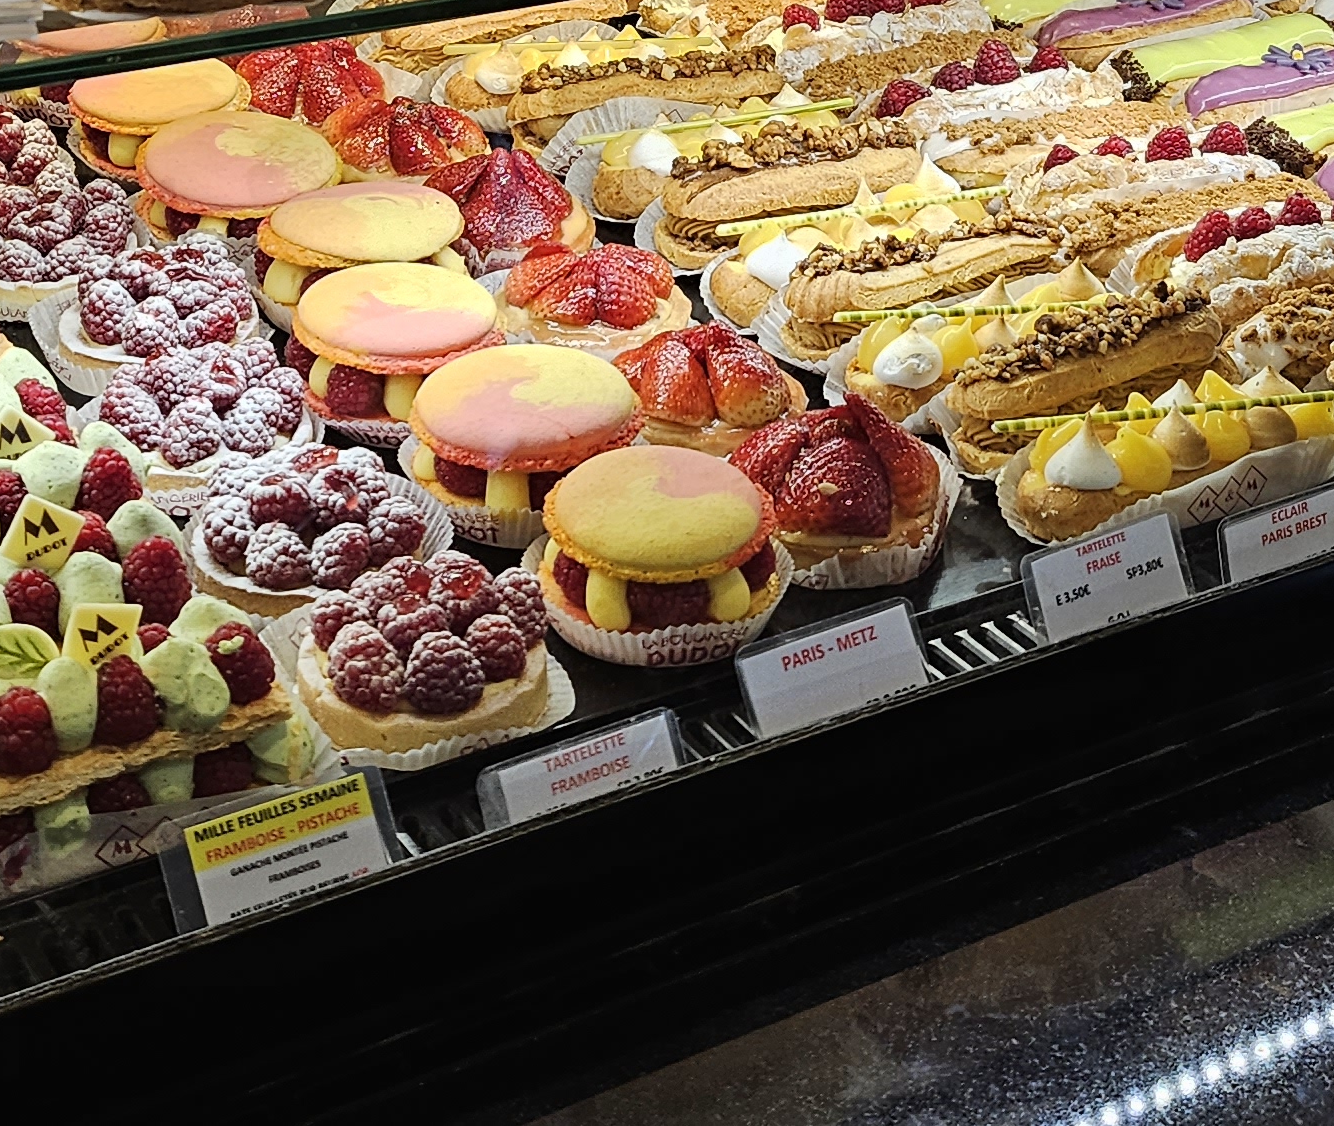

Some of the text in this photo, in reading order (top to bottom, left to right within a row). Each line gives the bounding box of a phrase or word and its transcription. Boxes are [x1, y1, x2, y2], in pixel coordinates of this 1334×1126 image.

[22, 507, 61, 547] M
[1261, 512, 1328, 548] PARIS BREST
[1271, 501, 1310, 525] ECLAIR
[25, 536, 68, 562] DUDOT
[1074, 531, 1128, 558] TARTELETTE
[1085, 551, 1123, 576] FRAISE
[1055, 584, 1093, 607] E 3,50€
[77, 613, 120, 653] M
[89, 633, 131, 666] DUDOT
[780, 642, 825, 672] PARIS
[835, 624, 879, 657] METZ
[542, 731, 627, 774] TARTELETTE
[550, 754, 632, 796] FRAMBOISE
[193, 778, 361, 844] MILLE FEUILLES SEMAINE
[205, 826, 286, 863] FRAMBOISE
[297, 801, 362, 833] PISTACHE
